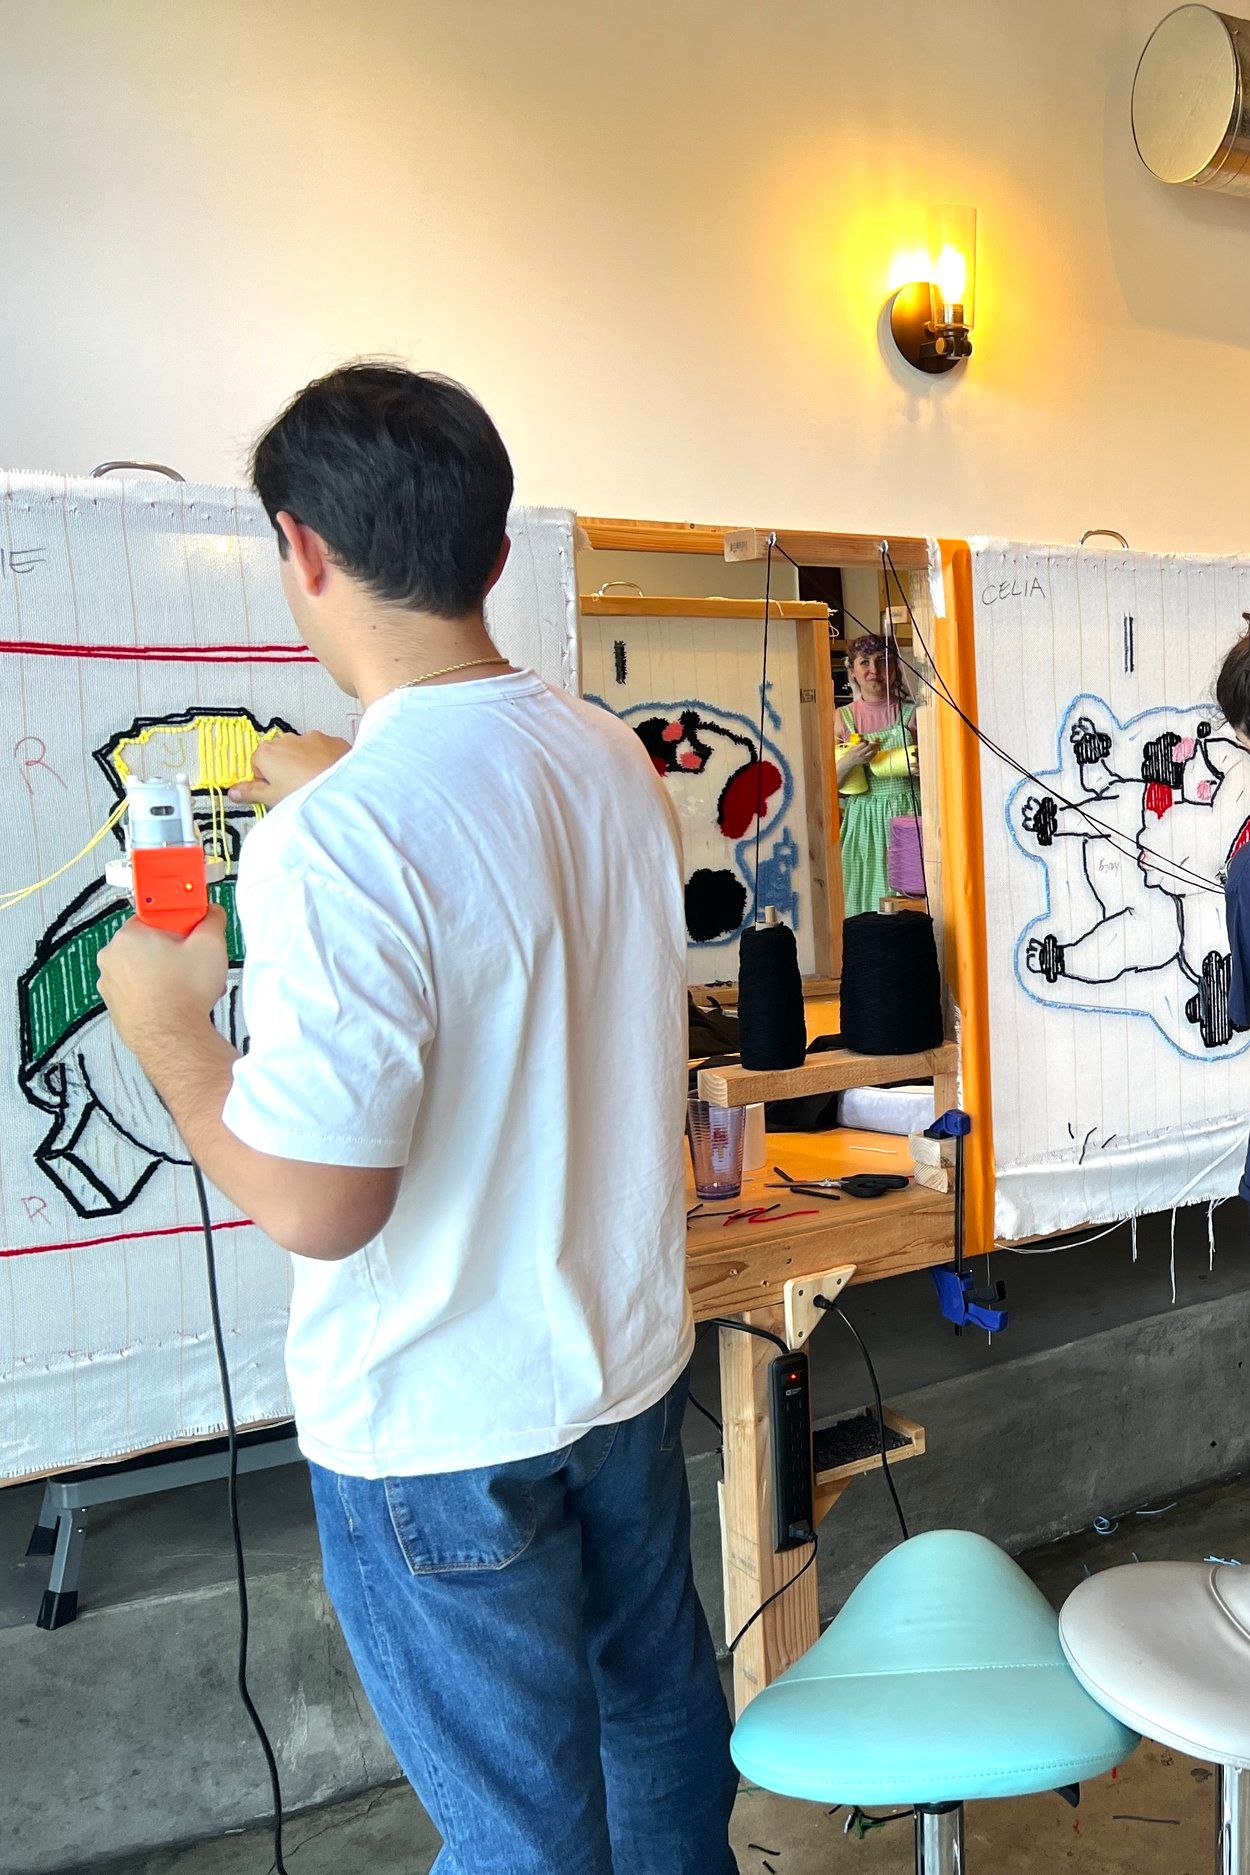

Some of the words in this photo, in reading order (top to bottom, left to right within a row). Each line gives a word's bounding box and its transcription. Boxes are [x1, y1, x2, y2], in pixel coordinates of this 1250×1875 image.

[981, 576, 1046, 606] CELIA
[14, 736, 69, 796] R
[20, 1195, 52, 1226] R
